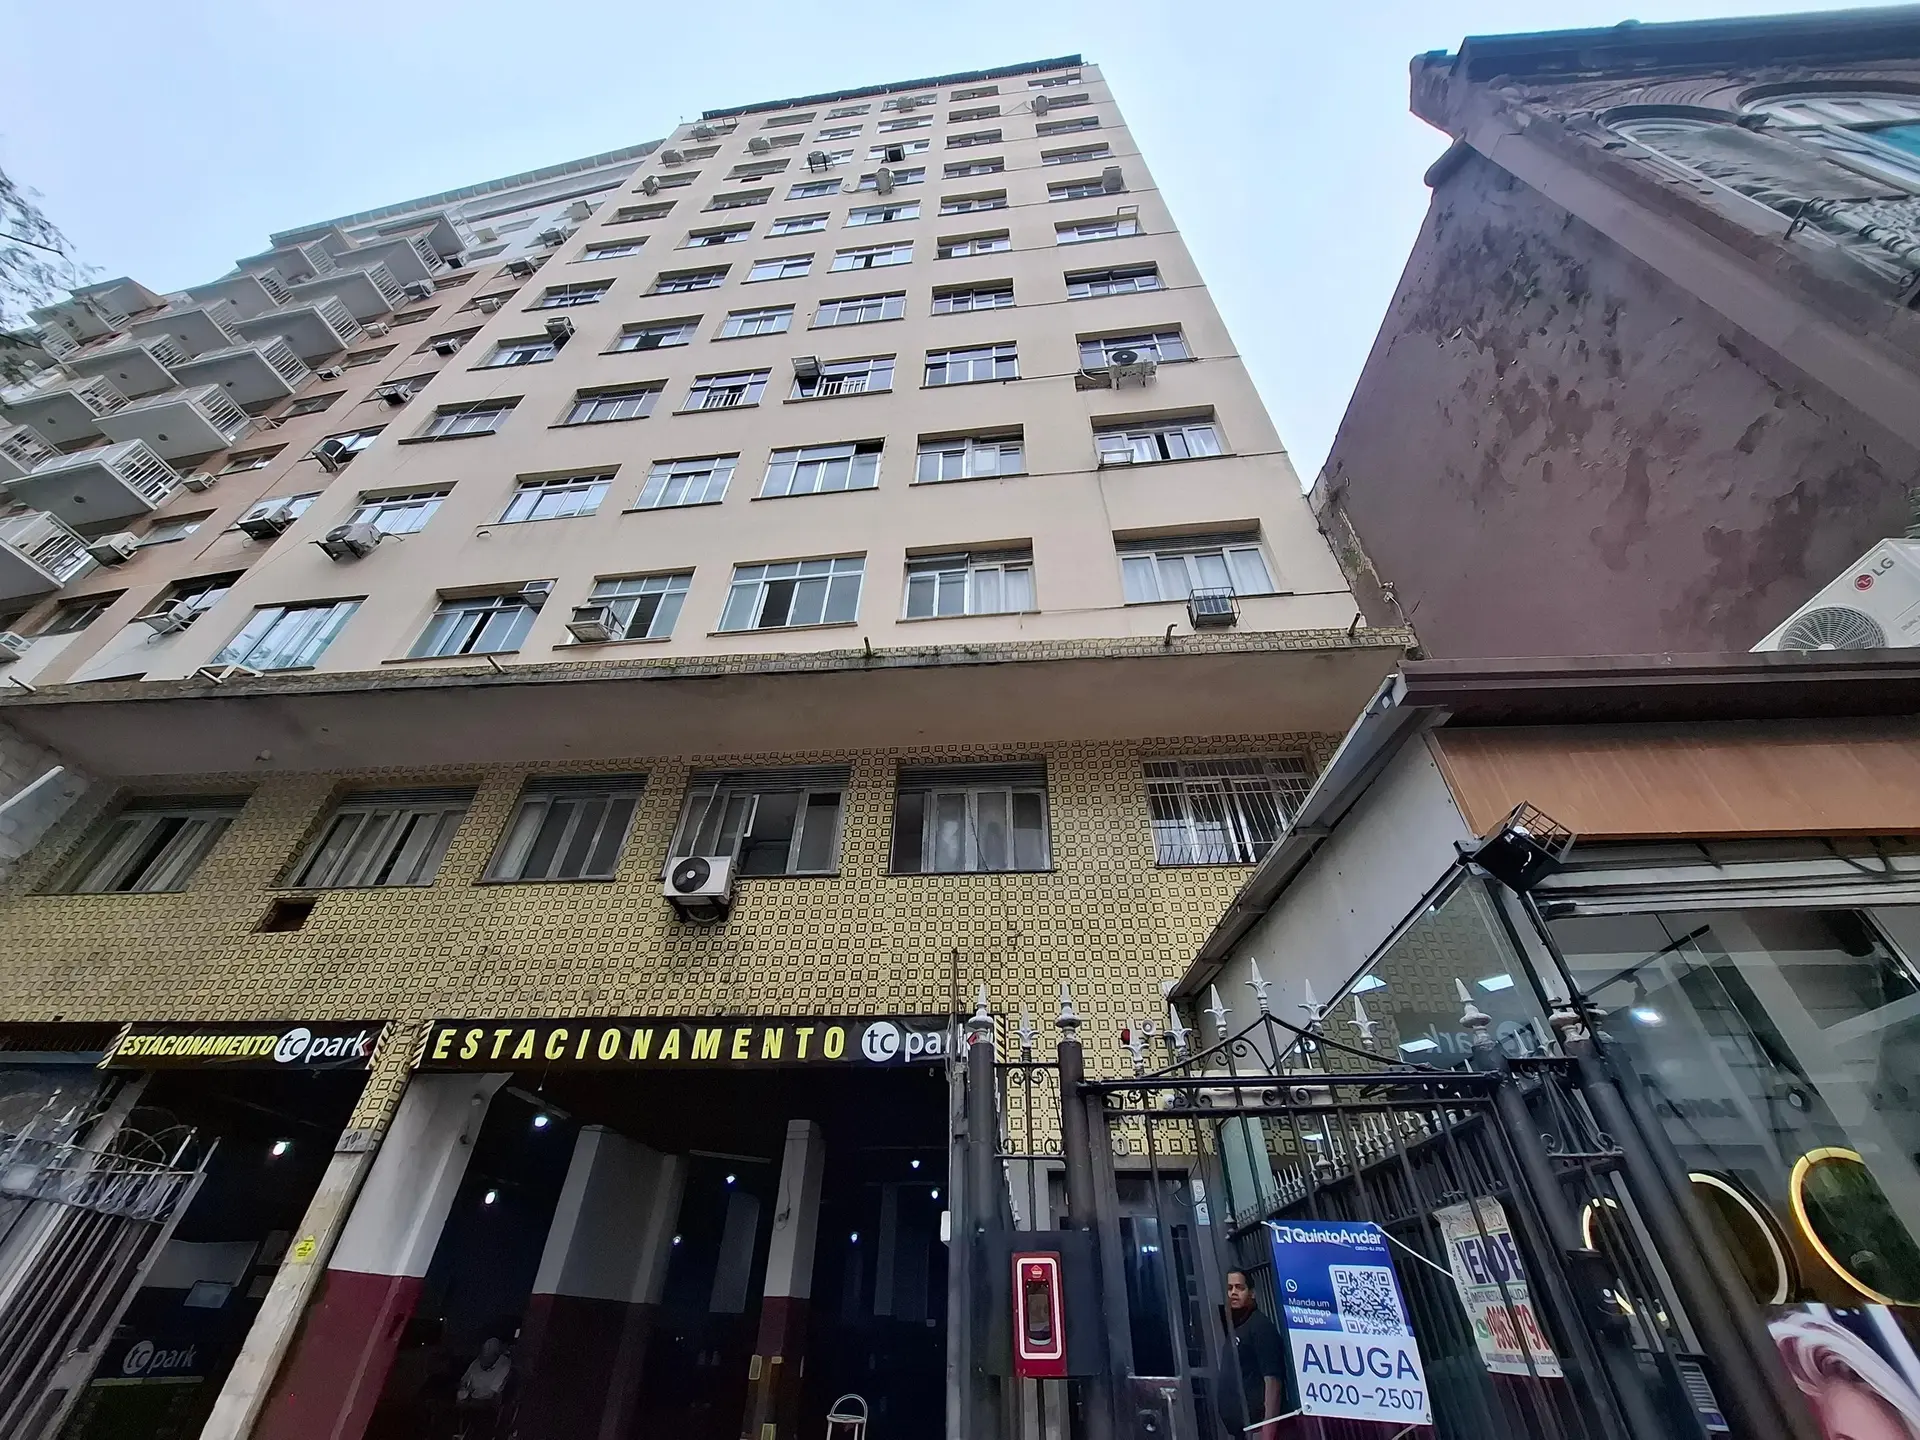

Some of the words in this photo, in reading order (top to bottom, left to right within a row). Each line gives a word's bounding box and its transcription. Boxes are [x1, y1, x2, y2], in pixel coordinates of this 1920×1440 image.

[1871, 557, 1895, 577] LG
[117, 1035, 278, 1056] ESTACIONAMENTO
[304, 1030, 371, 1063] park
[432, 1026, 846, 1060] ESTACIONAMENTO
[1292, 1228, 1382, 1245] QuintoAndar
[1455, 1232, 1526, 1285] VENDE
[1288, 1298, 1316, 1307] Mande
[1317, 1300, 1330, 1308] um
[1290, 1306, 1331, 1317] Whatsapp
[1292, 1316, 1304, 1324] ou
[146, 1344, 197, 1374] park
[1302, 1343, 1420, 1381] ALUGA
[1305, 1382, 1423, 1411] 4020-2507
